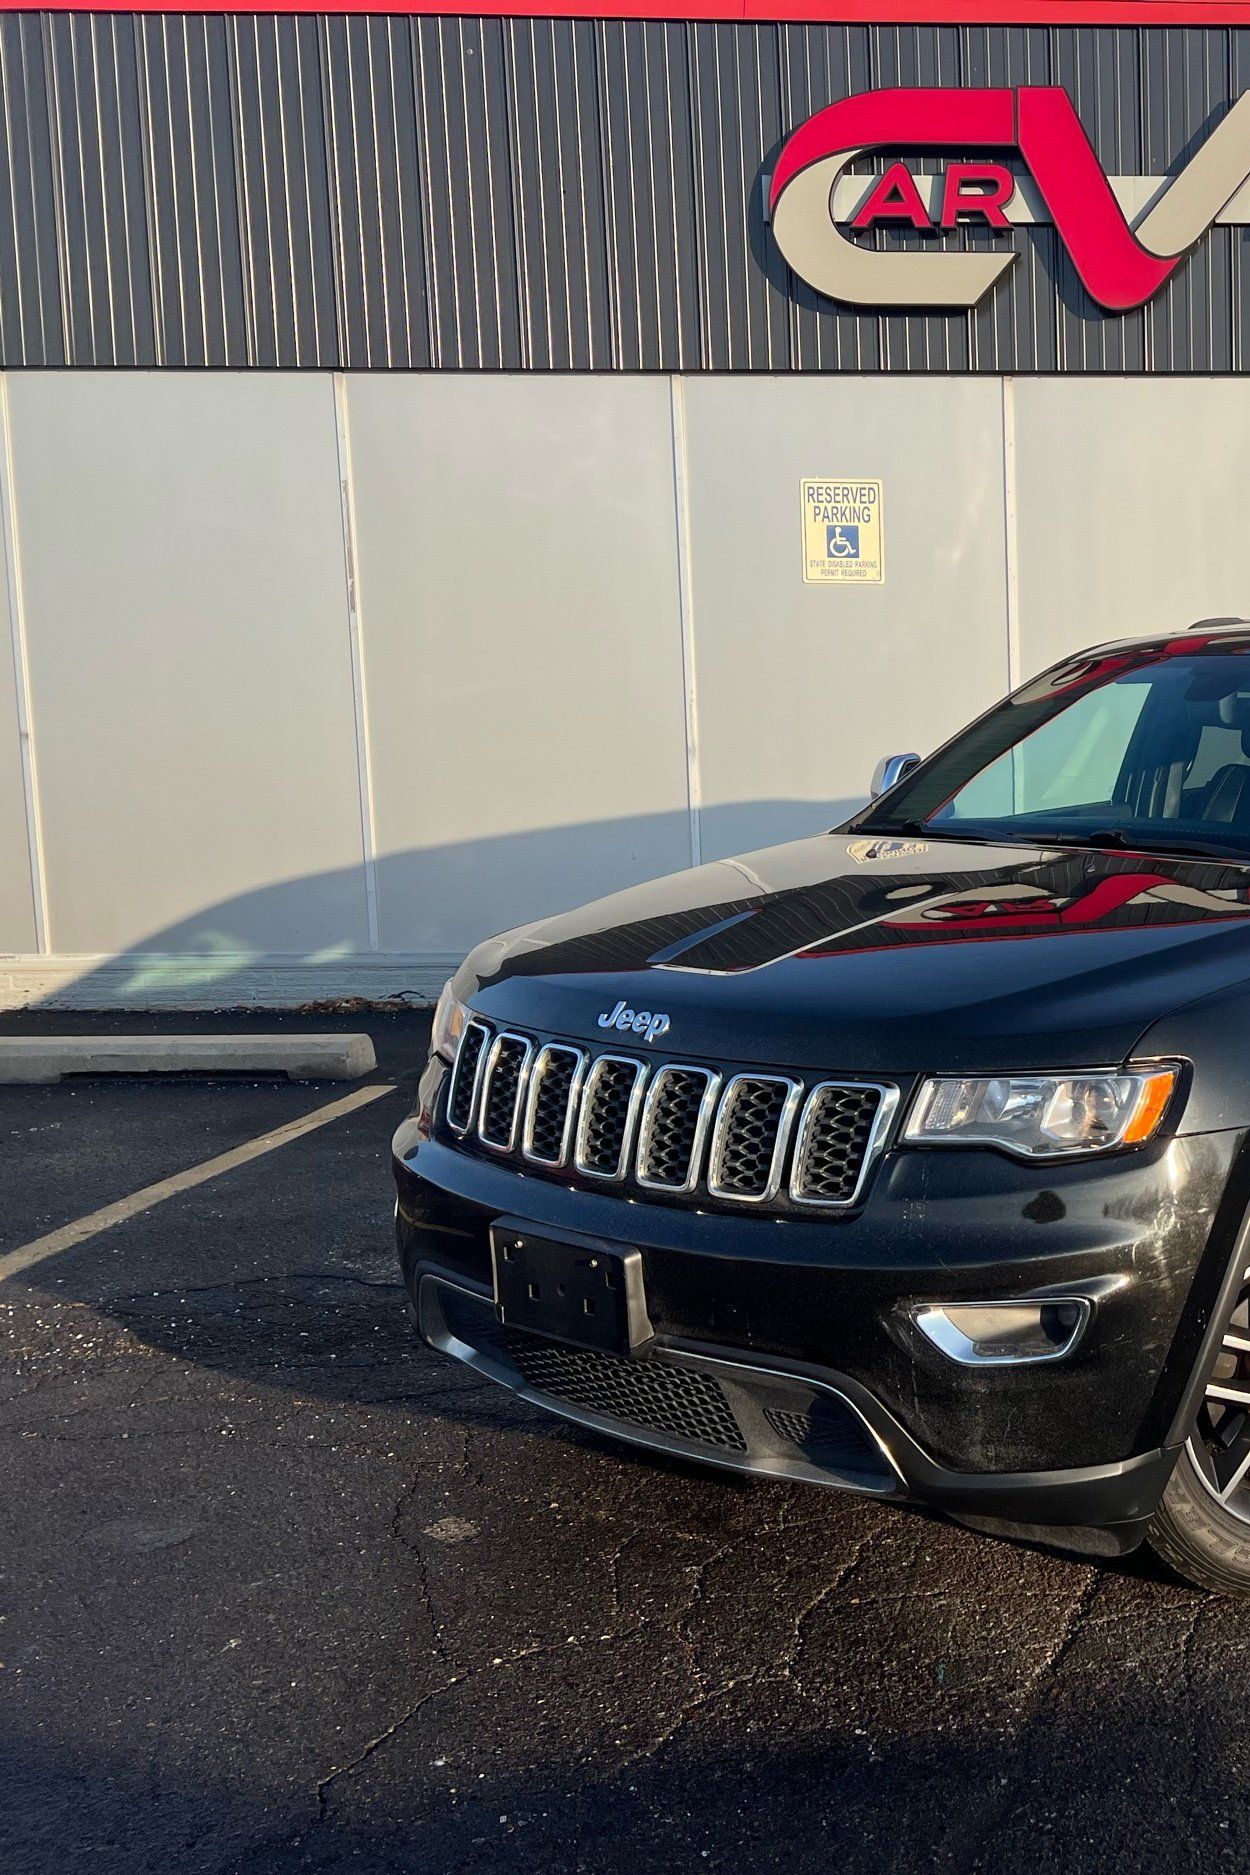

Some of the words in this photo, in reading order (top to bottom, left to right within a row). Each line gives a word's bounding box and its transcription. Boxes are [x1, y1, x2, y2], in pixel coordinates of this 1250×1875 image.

[807, 486, 876, 504] RESERVED
[813, 505, 871, 523] PARKING
[809, 560, 827, 568] STATE
[828, 560, 853, 568] DISABLED
[854, 560, 878, 569] PARKING
[820, 569, 839, 577] PERMIT
[840, 569, 867, 578] REQUIRED
[597, 1001, 671, 1043] Jeep
